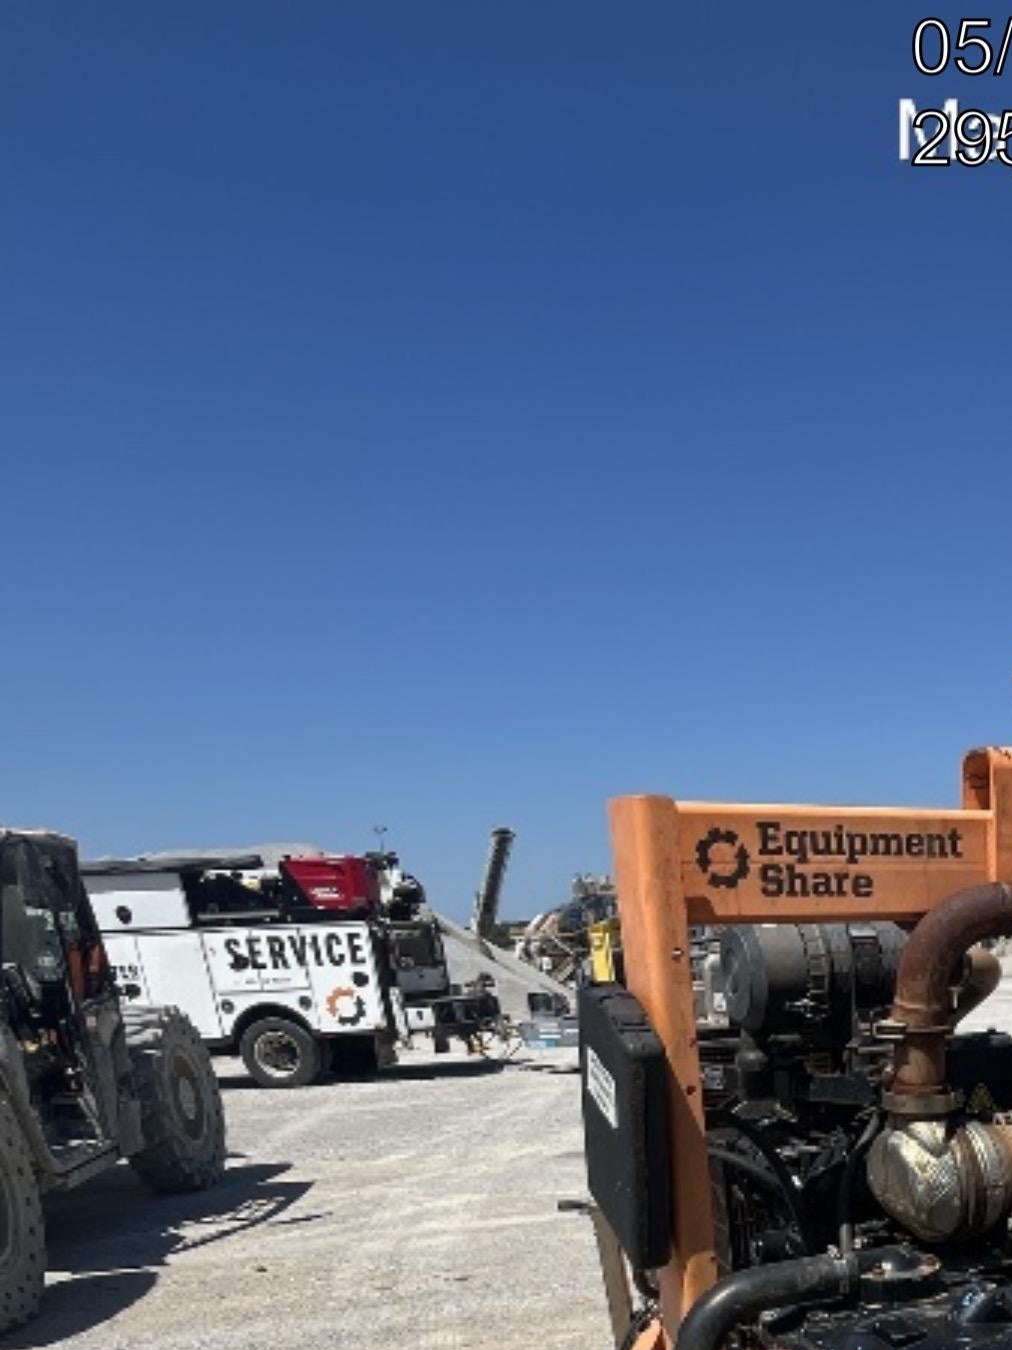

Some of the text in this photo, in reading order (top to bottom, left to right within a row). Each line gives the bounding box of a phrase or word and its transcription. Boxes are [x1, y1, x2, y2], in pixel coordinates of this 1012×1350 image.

[756, 821, 963, 864] Equipment
[760, 863, 875, 898] Share
[223, 932, 367, 973] SERVICE
